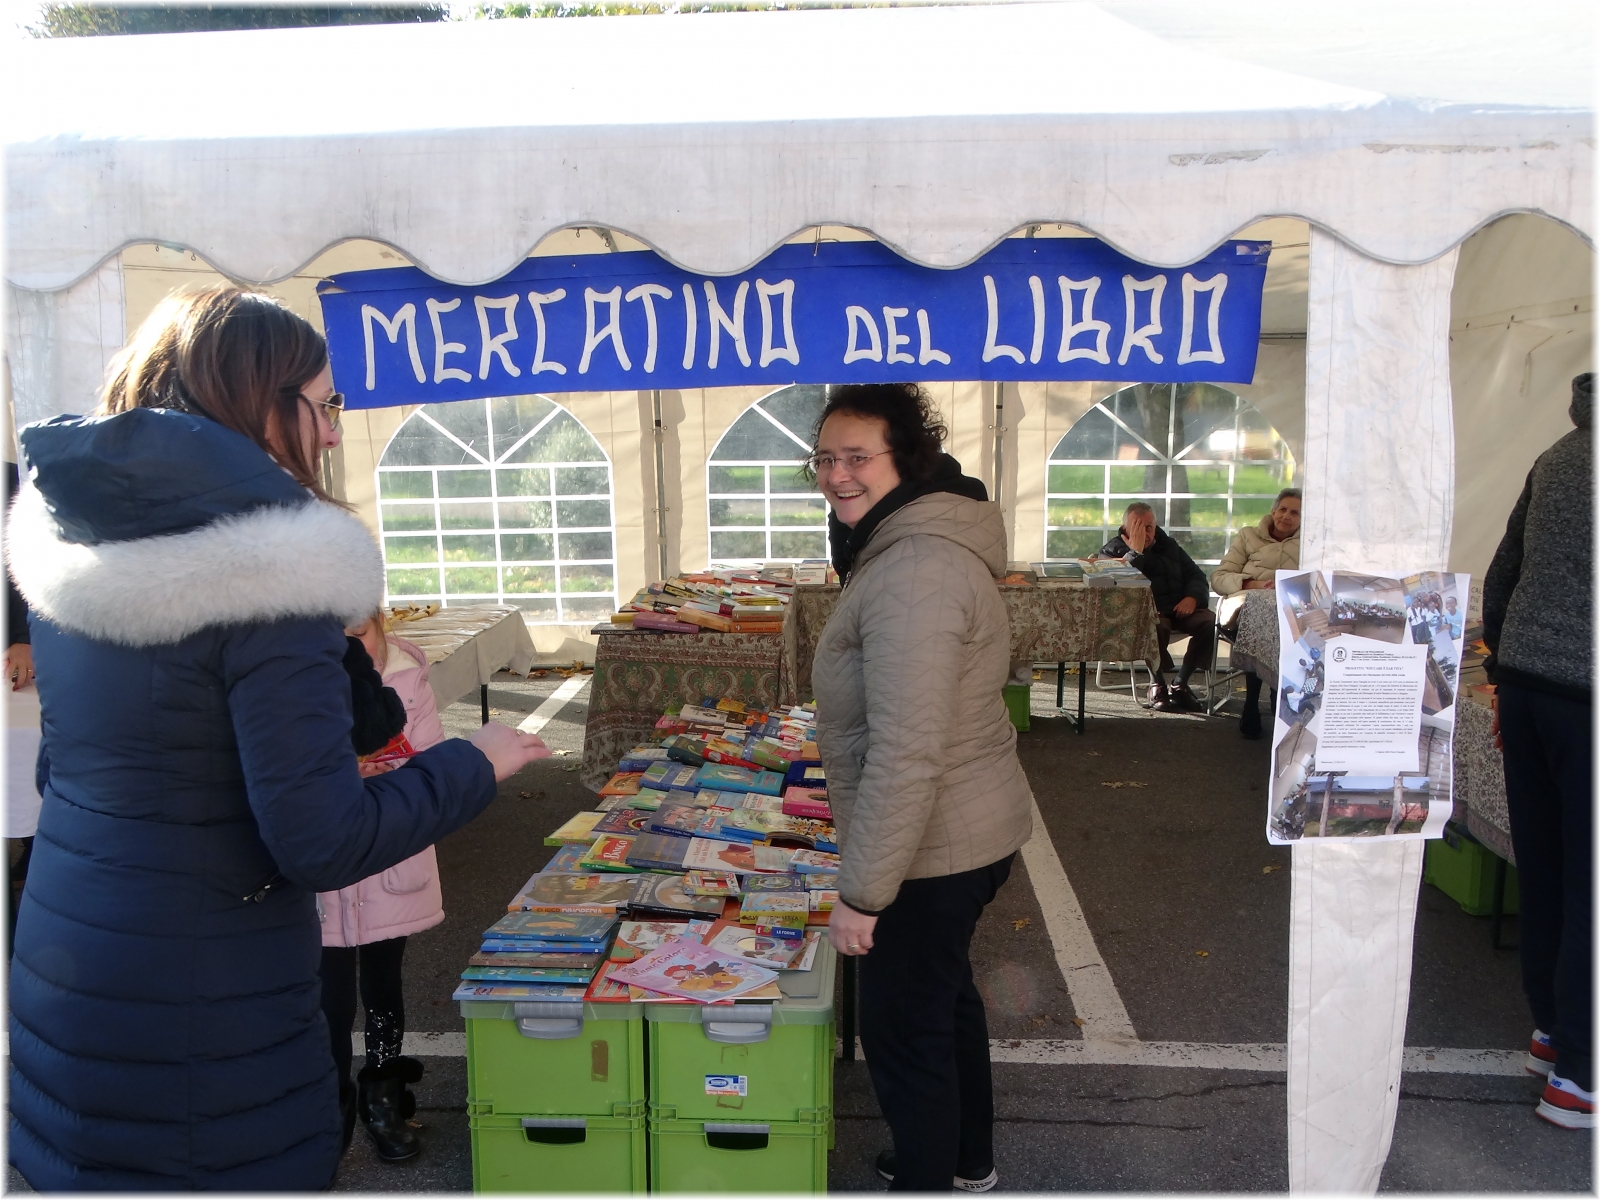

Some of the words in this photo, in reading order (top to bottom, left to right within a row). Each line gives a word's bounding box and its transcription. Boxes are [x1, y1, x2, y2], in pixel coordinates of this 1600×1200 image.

[361, 278, 800, 390] MERCATINO
[843, 305, 952, 366] DEL
[981, 272, 1229, 366] LIBRO
[603, 840, 628, 860] Bosco
